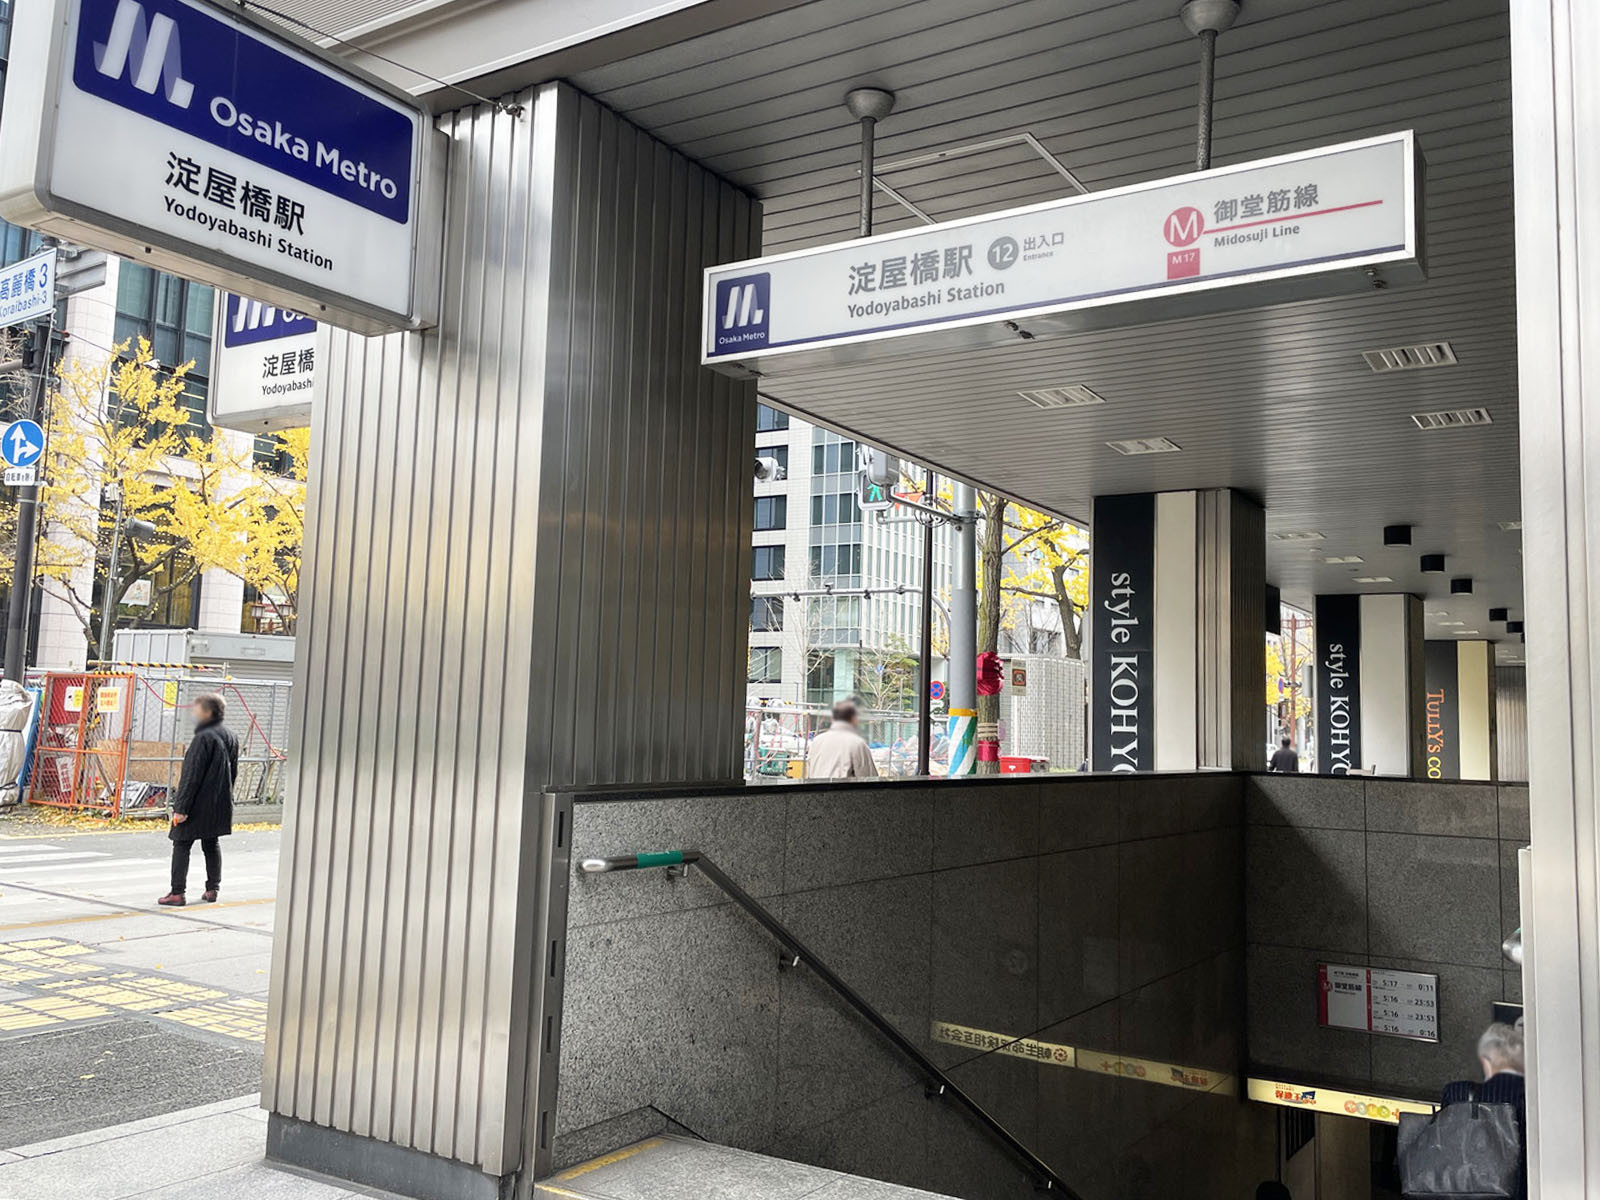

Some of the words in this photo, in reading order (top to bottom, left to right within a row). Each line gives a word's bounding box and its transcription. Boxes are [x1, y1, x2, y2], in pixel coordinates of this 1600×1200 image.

[210, 96, 309, 162] Osaka
[315, 141, 398, 200] Metro
[165, 151, 305, 236] 淀屋橋駅
[1214, 183, 1319, 224] 御堂筋線
[164, 196, 273, 249] Yodoyabashi
[277, 238, 333, 271] Station
[1023, 232, 1064, 251] 出入口
[1213, 227, 1268, 248] Midosuji
[1272, 223, 1300, 238] Line
[848, 244, 973, 296] 淀屋橋駅
[992, 243, 1014, 264] 12
[0, 290, 47, 318] oraibashi-3
[847, 288, 942, 319] Yodoyabashi
[946, 281, 1005, 302] Station
[719, 336, 742, 345] Osaka
[742, 331, 766, 341] Metro
[262, 347, 315, 378] 淀屋橋
[1104, 572, 1139, 644] style
[1325, 643, 1349, 689] style
[1382, 979, 1398, 988] 5:17
